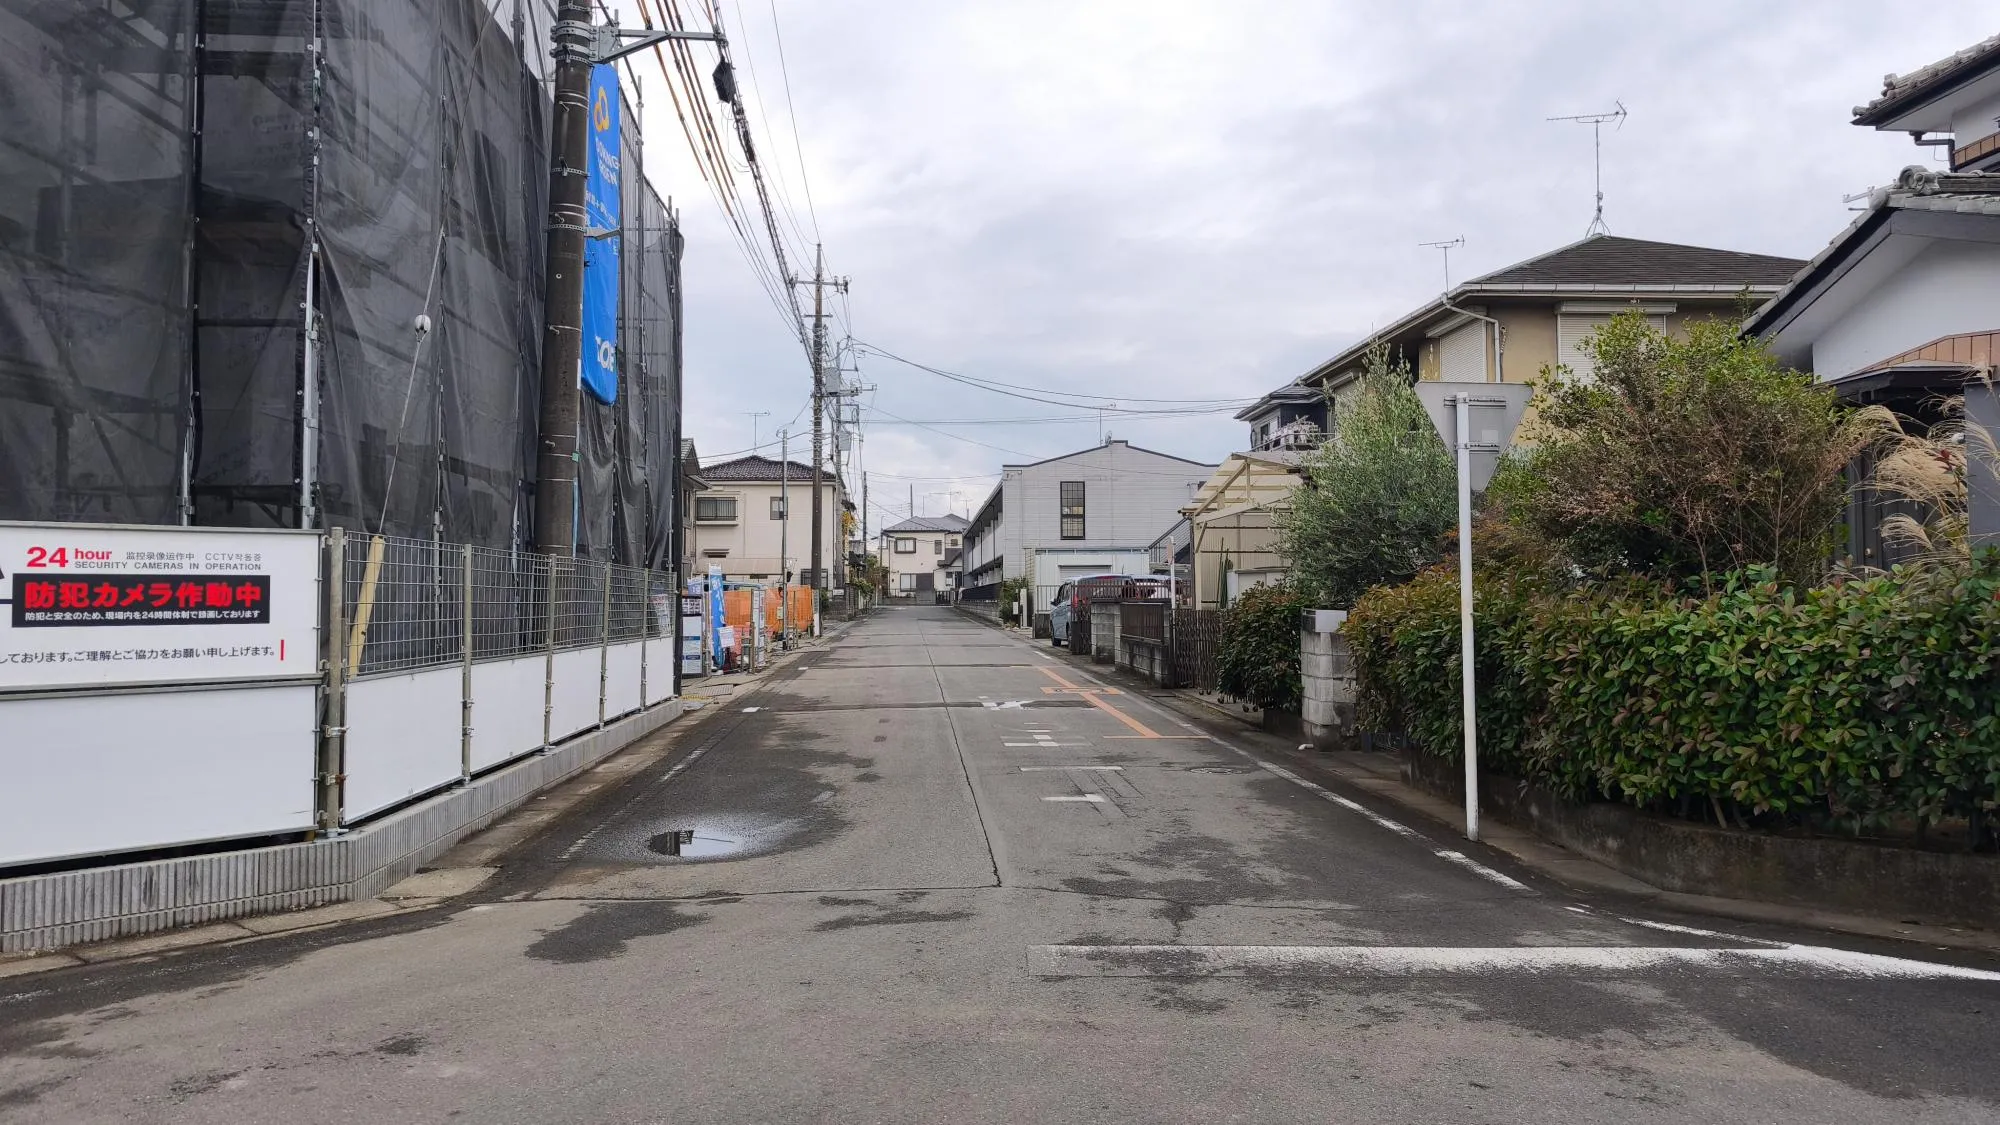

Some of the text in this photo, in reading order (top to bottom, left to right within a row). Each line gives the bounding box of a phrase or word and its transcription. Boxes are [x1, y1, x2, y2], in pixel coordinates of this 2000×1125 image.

[26, 546, 112, 568] 24 hour
[74, 561, 262, 571] SECURITY CAMERAS IN OPERATION
[24, 581, 261, 608] 防犯カメラ作動中
